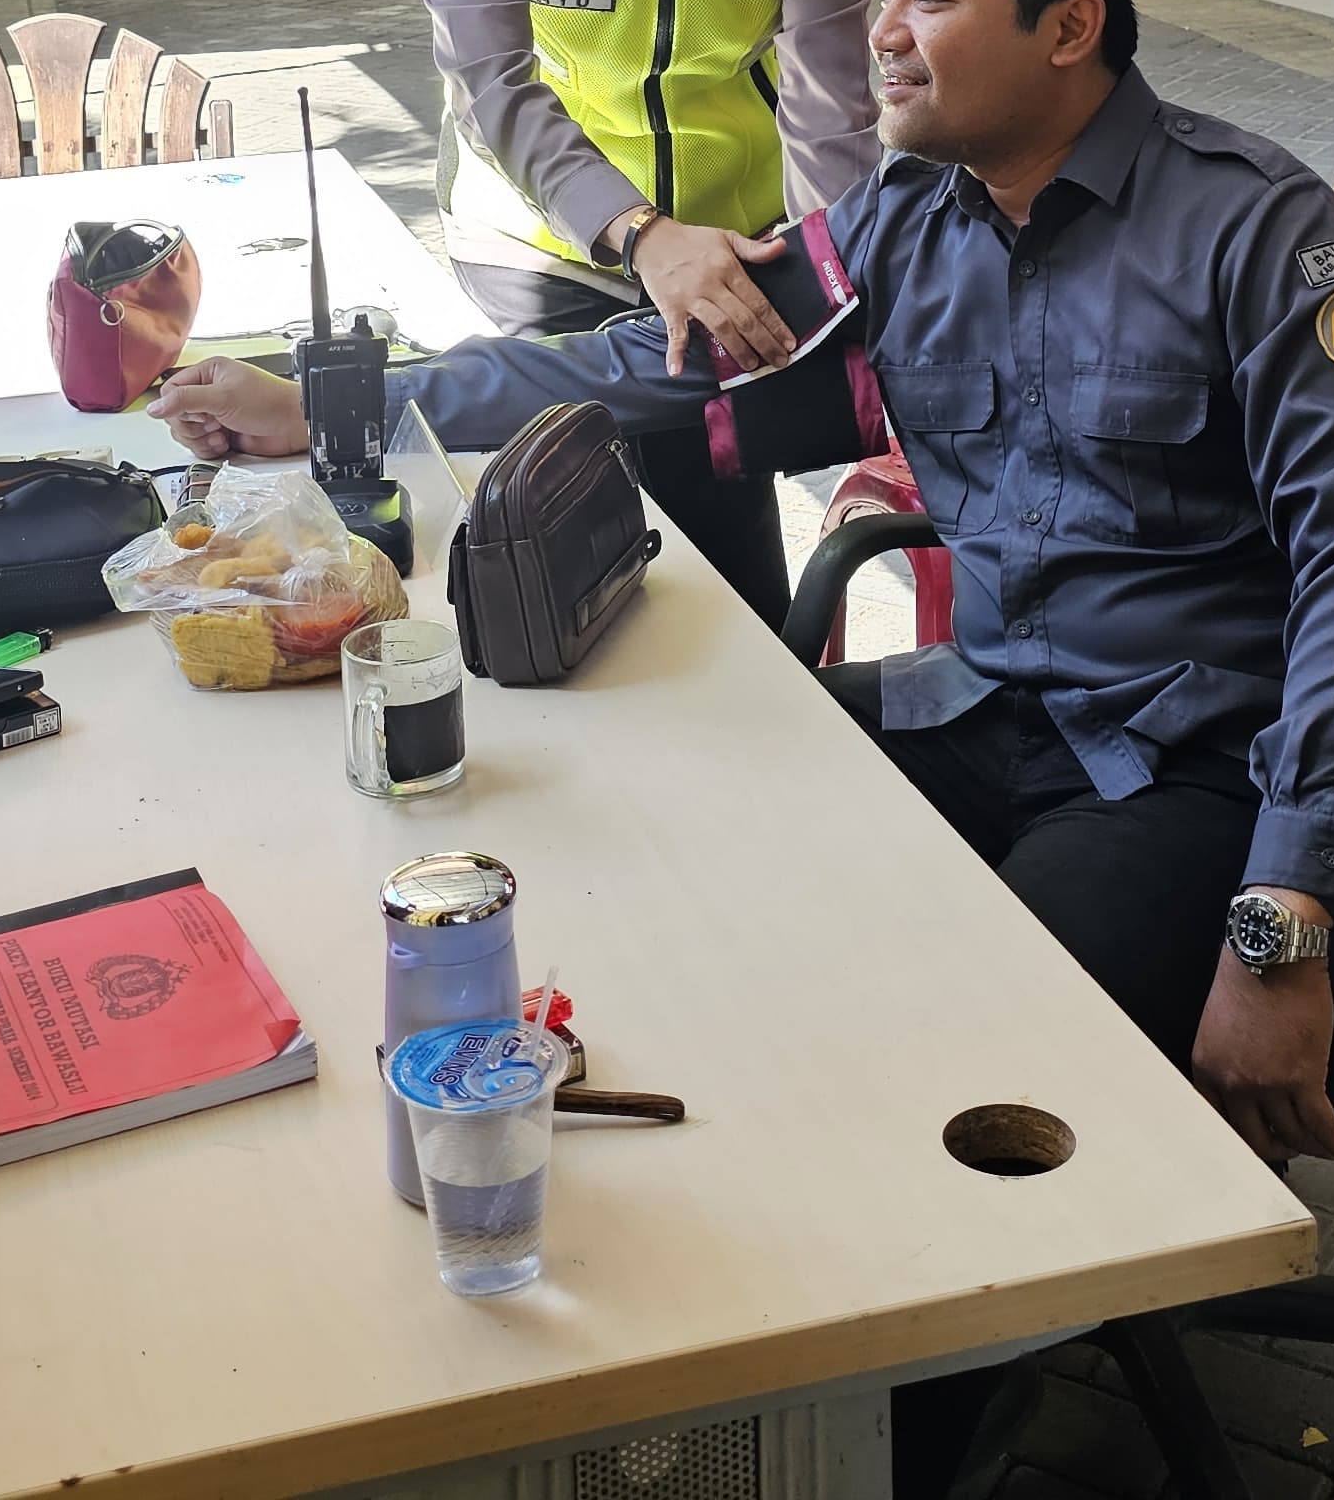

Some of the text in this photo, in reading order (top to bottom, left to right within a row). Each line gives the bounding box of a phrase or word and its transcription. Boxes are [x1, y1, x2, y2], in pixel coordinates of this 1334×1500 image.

[821, 260, 840, 288] INDEX
[0, 938, 88, 1096] PIKET KANTOR BAWASLU
[42, 957, 100, 1051] BUKU MUTASI
[7, 1045, 35, 1084] SEMERU
[429, 1034, 492, 1086] EVINS
